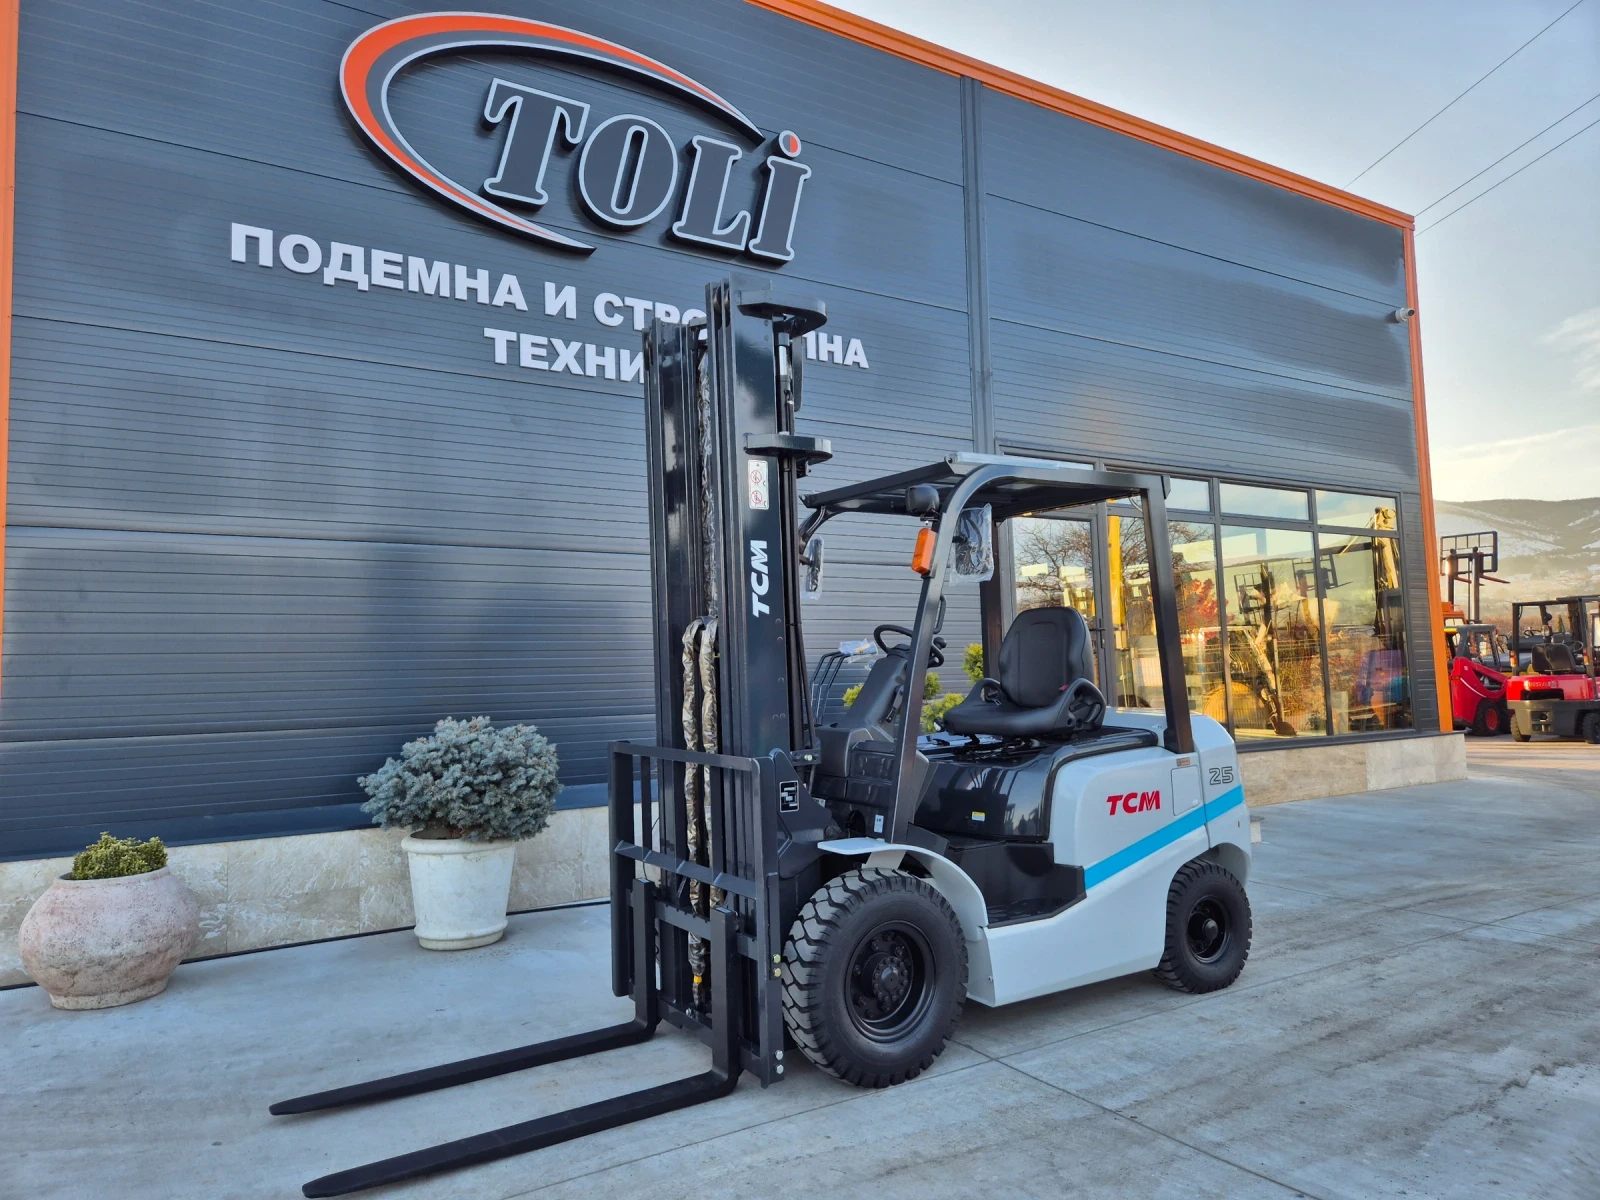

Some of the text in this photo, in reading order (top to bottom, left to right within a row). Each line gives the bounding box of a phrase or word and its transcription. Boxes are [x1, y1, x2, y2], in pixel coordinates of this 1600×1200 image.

[230, 222, 529, 313] ПОДЕМНА
[544, 281, 577, 319] И
[484, 327, 644, 384] ТЕХНИ
[750, 540, 769, 617] TCM
[1106, 790, 1161, 816] TCM
[1209, 766, 1234, 786] 25
